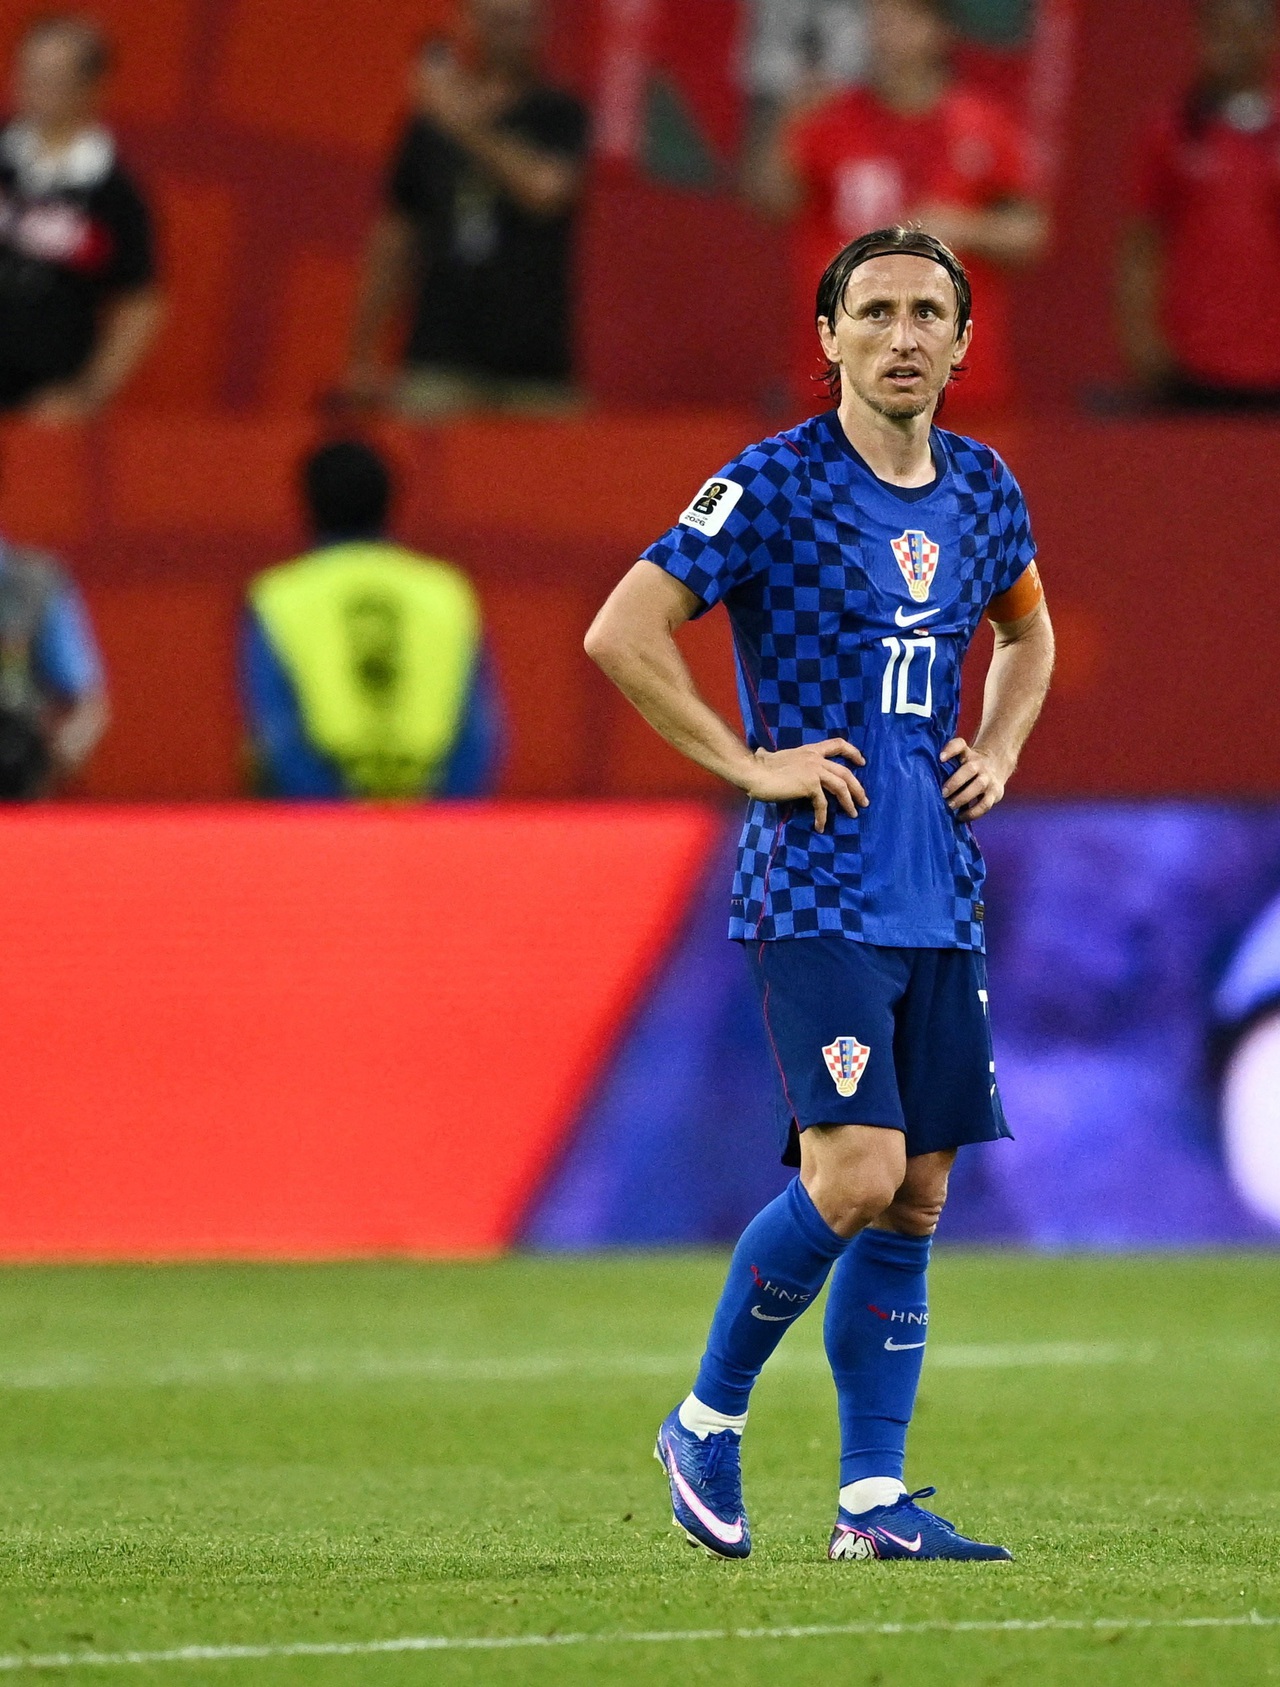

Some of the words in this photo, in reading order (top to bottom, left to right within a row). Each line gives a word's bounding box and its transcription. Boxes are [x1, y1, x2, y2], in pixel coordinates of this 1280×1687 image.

[684, 514, 706, 527] 2026
[910, 537, 923, 573] HNS
[881, 636, 936, 718] 10
[763, 1280, 811, 1303] HNS
[891, 1310, 929, 1326] HNS
